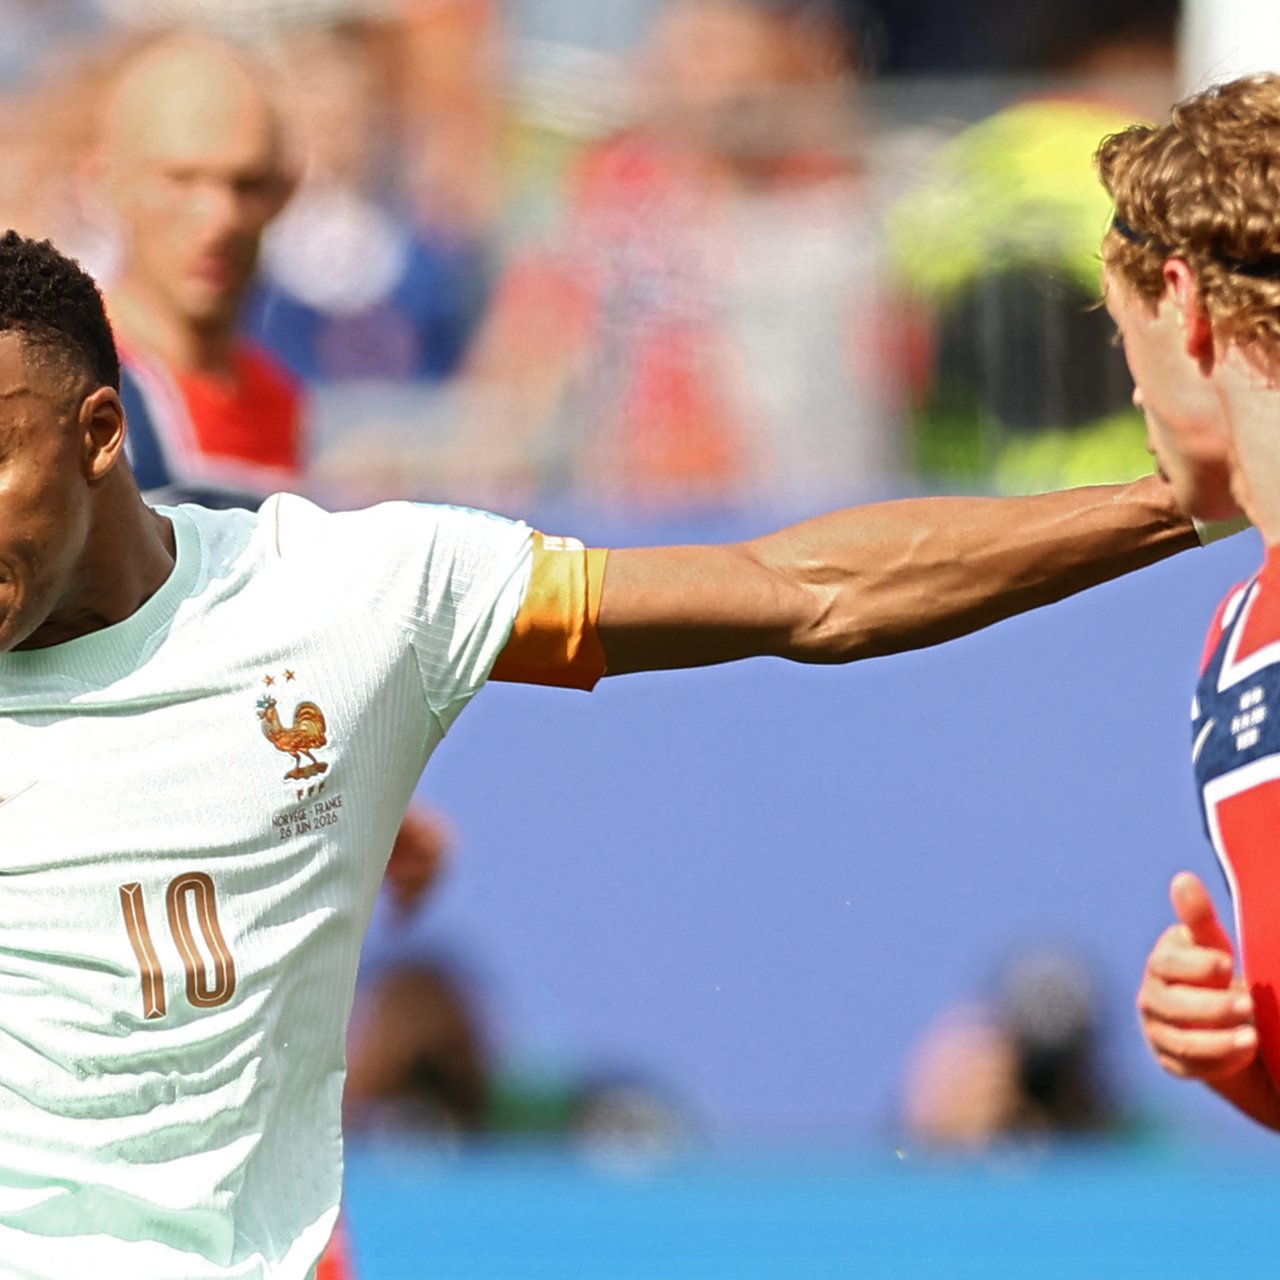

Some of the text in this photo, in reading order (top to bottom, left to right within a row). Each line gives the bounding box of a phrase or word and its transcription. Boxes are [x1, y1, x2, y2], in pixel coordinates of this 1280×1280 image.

[279, 826, 292, 840] 26
[313, 810, 338, 830] 2026
[119, 871, 236, 1020] 10
